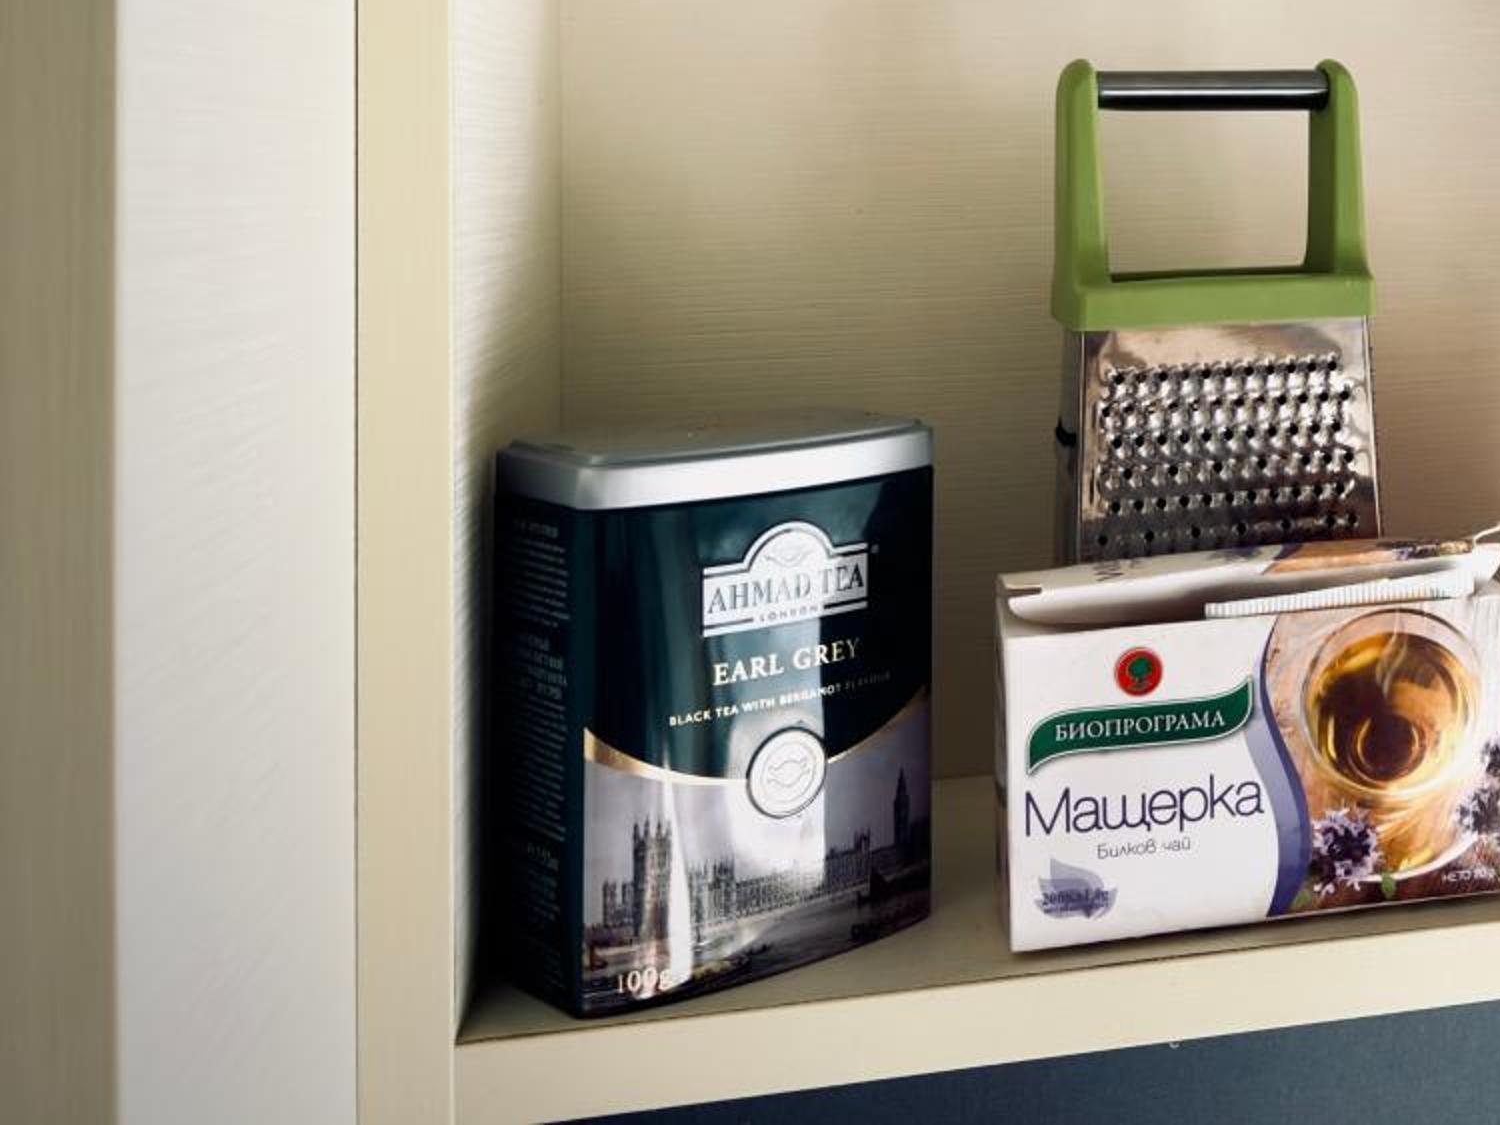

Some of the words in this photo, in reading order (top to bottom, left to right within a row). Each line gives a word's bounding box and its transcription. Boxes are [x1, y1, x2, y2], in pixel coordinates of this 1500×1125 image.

[707, 572, 812, 615] AHMAD
[817, 562, 865, 595] TEA
[759, 605, 819, 622] LONDON
[712, 652, 785, 686] EARL
[792, 637, 861, 671] GREY
[669, 709, 711, 727] BLACK
[716, 704, 739, 719] TEA
[742, 697, 775, 712] WITH
[779, 684, 842, 705] BERGAMOT
[1055, 710, 1226, 742] БИОПРОГРАМА
[1025, 773, 1264, 838] Мащерка
[1096, 837, 1157, 860] Билков
[1161, 836, 1191, 852] чай
